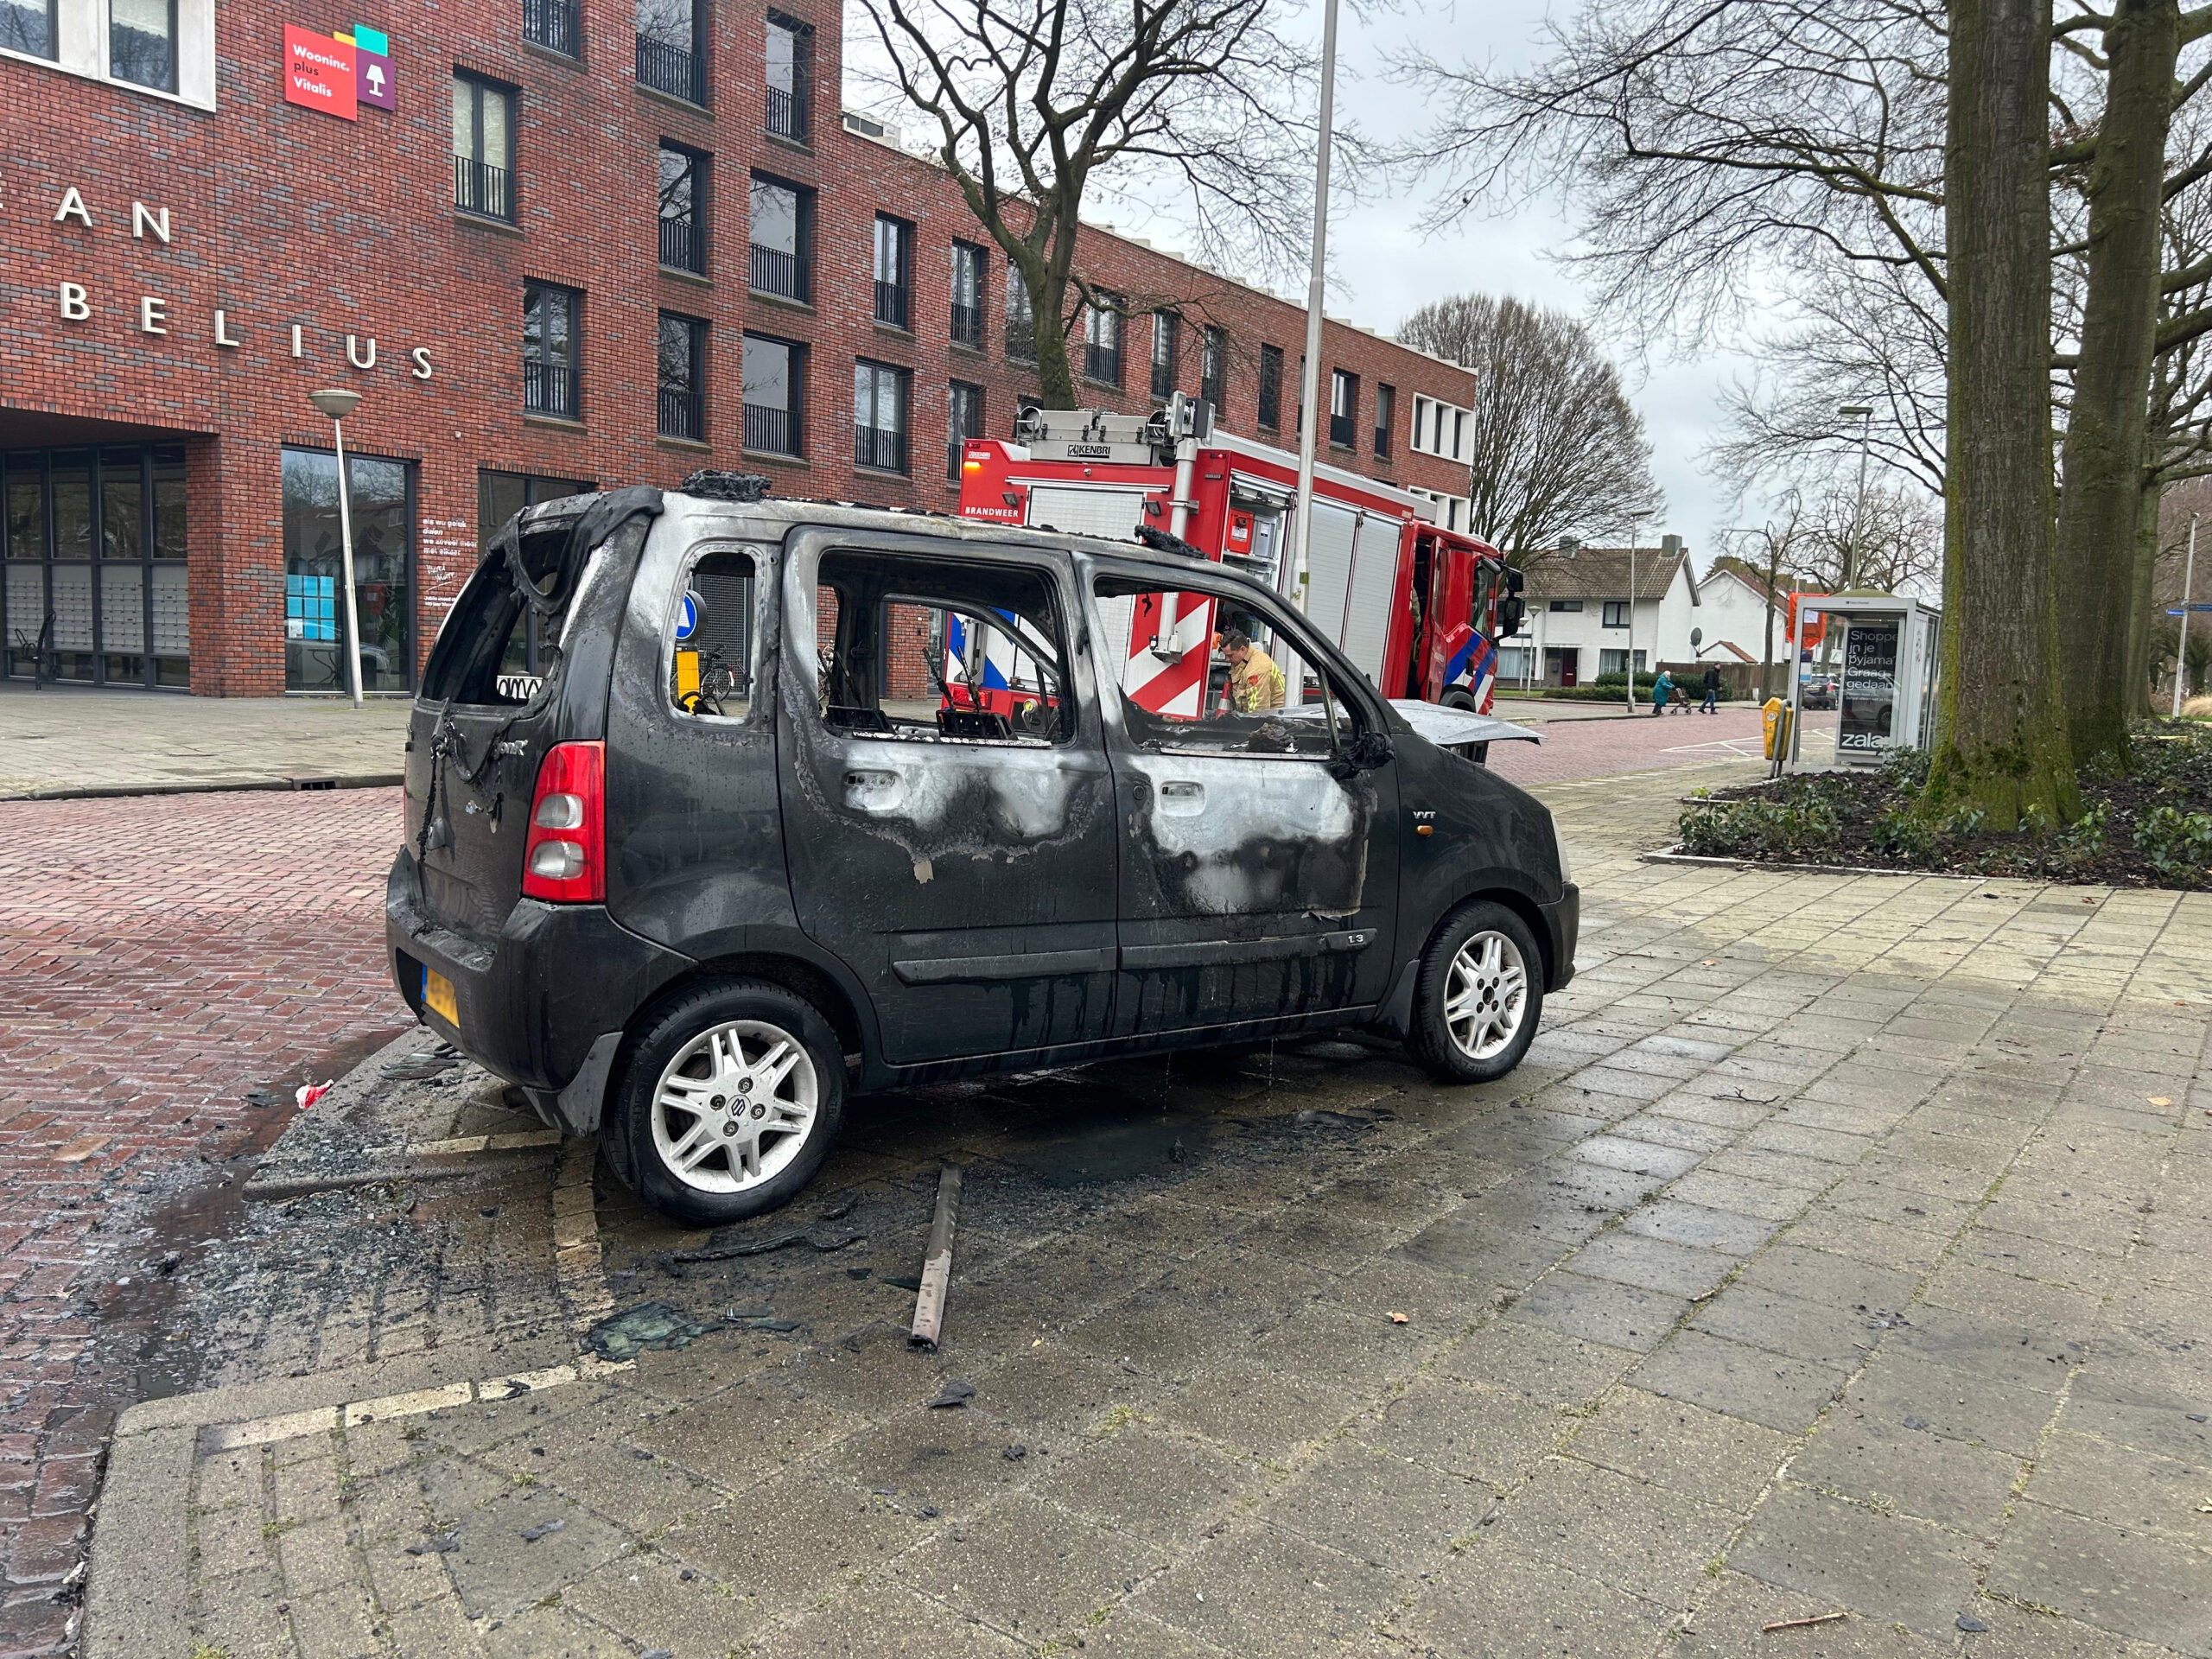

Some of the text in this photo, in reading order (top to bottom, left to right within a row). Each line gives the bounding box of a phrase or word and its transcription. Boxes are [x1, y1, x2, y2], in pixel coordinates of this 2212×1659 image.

[293, 43, 350, 73] Wooninc.
[294, 61, 319, 76] plus
[294, 76, 332, 97] Vitalis
[60, 282, 432, 379] BELIUS
[1079, 445, 1111, 455] KENBRI
[965, 506, 1019, 518] BRANDWEER
[1863, 642, 1875, 654] je
[1847, 666, 1886, 680] Graag
[1413, 810, 1436, 819] VVT
